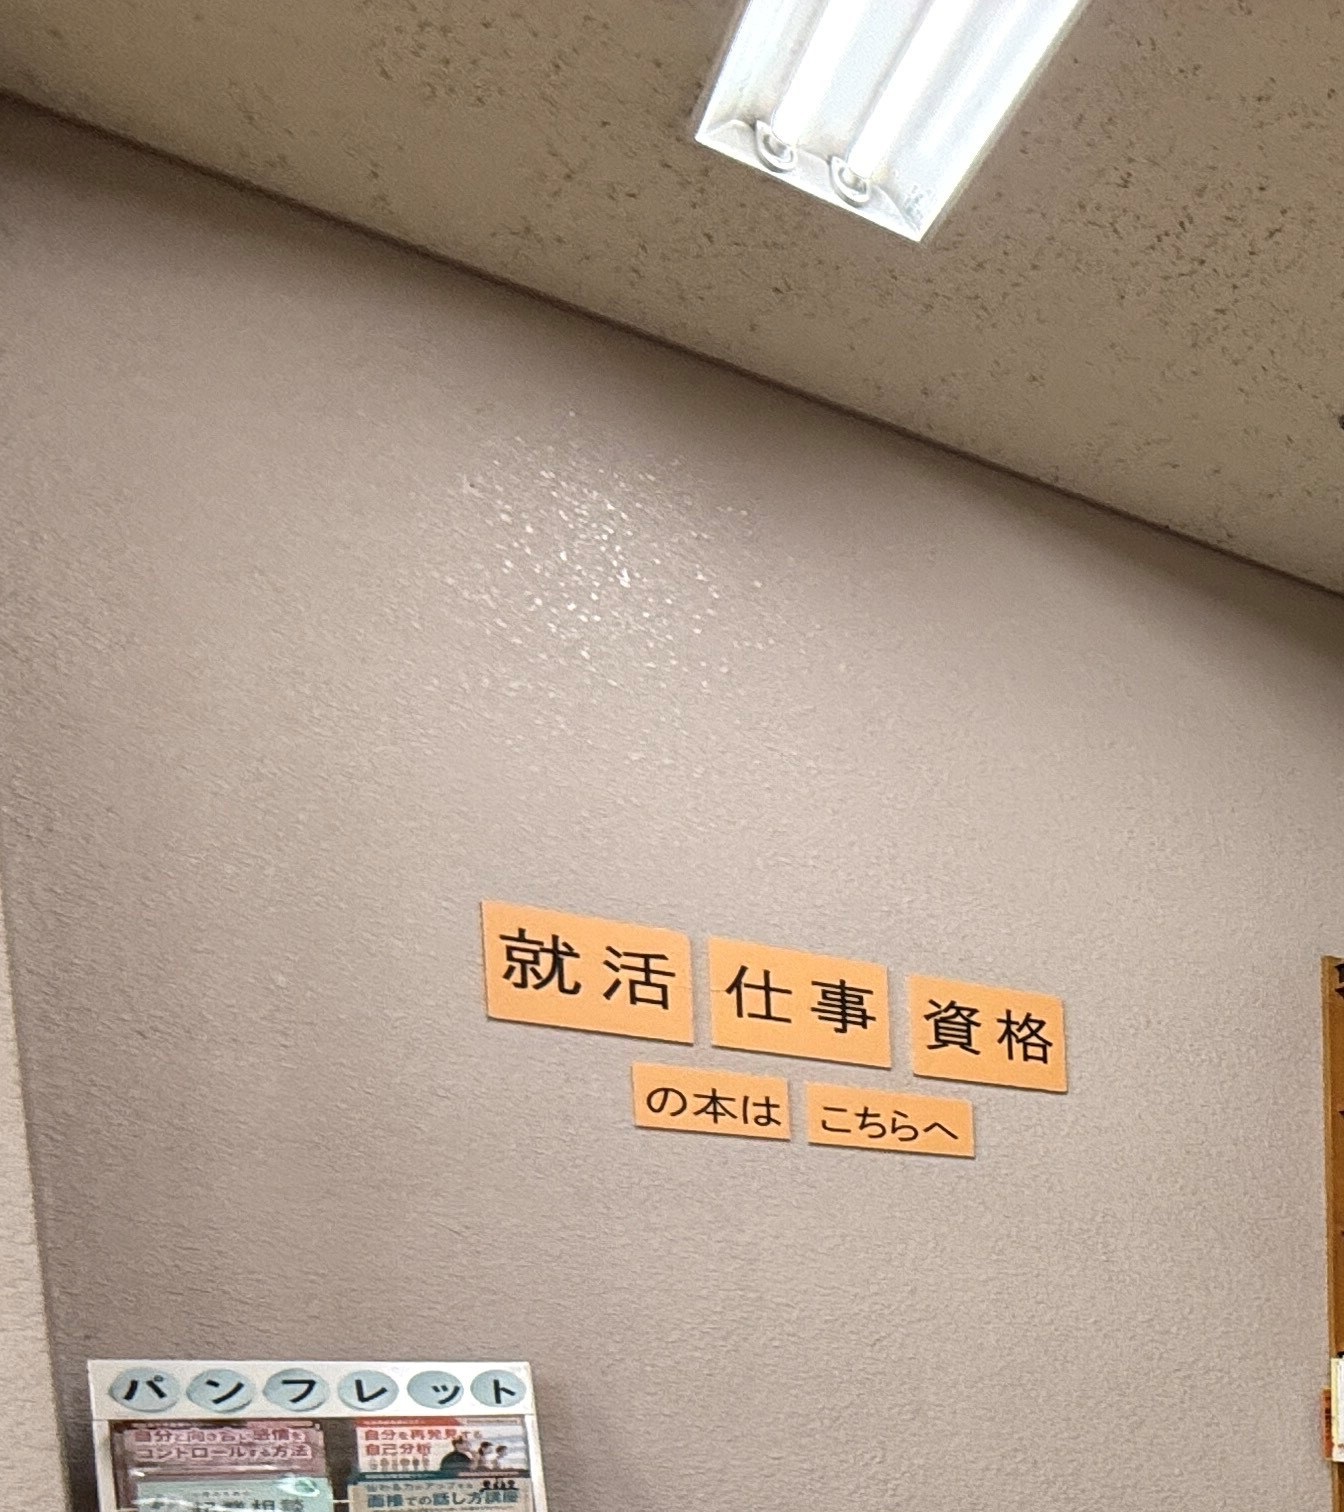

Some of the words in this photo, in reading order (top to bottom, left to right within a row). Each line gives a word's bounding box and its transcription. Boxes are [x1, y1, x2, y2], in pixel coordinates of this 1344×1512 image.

[499, 927, 676, 1011] 就活
[725, 964, 876, 1034] 仕事
[922, 998, 1054, 1065] 資格
[646, 1085, 782, 1127] の本は
[820, 1104, 959, 1143] こちらへ
[124, 1374, 516, 1405] パンフレット
[365, 1442, 432, 1457] 自己分析
